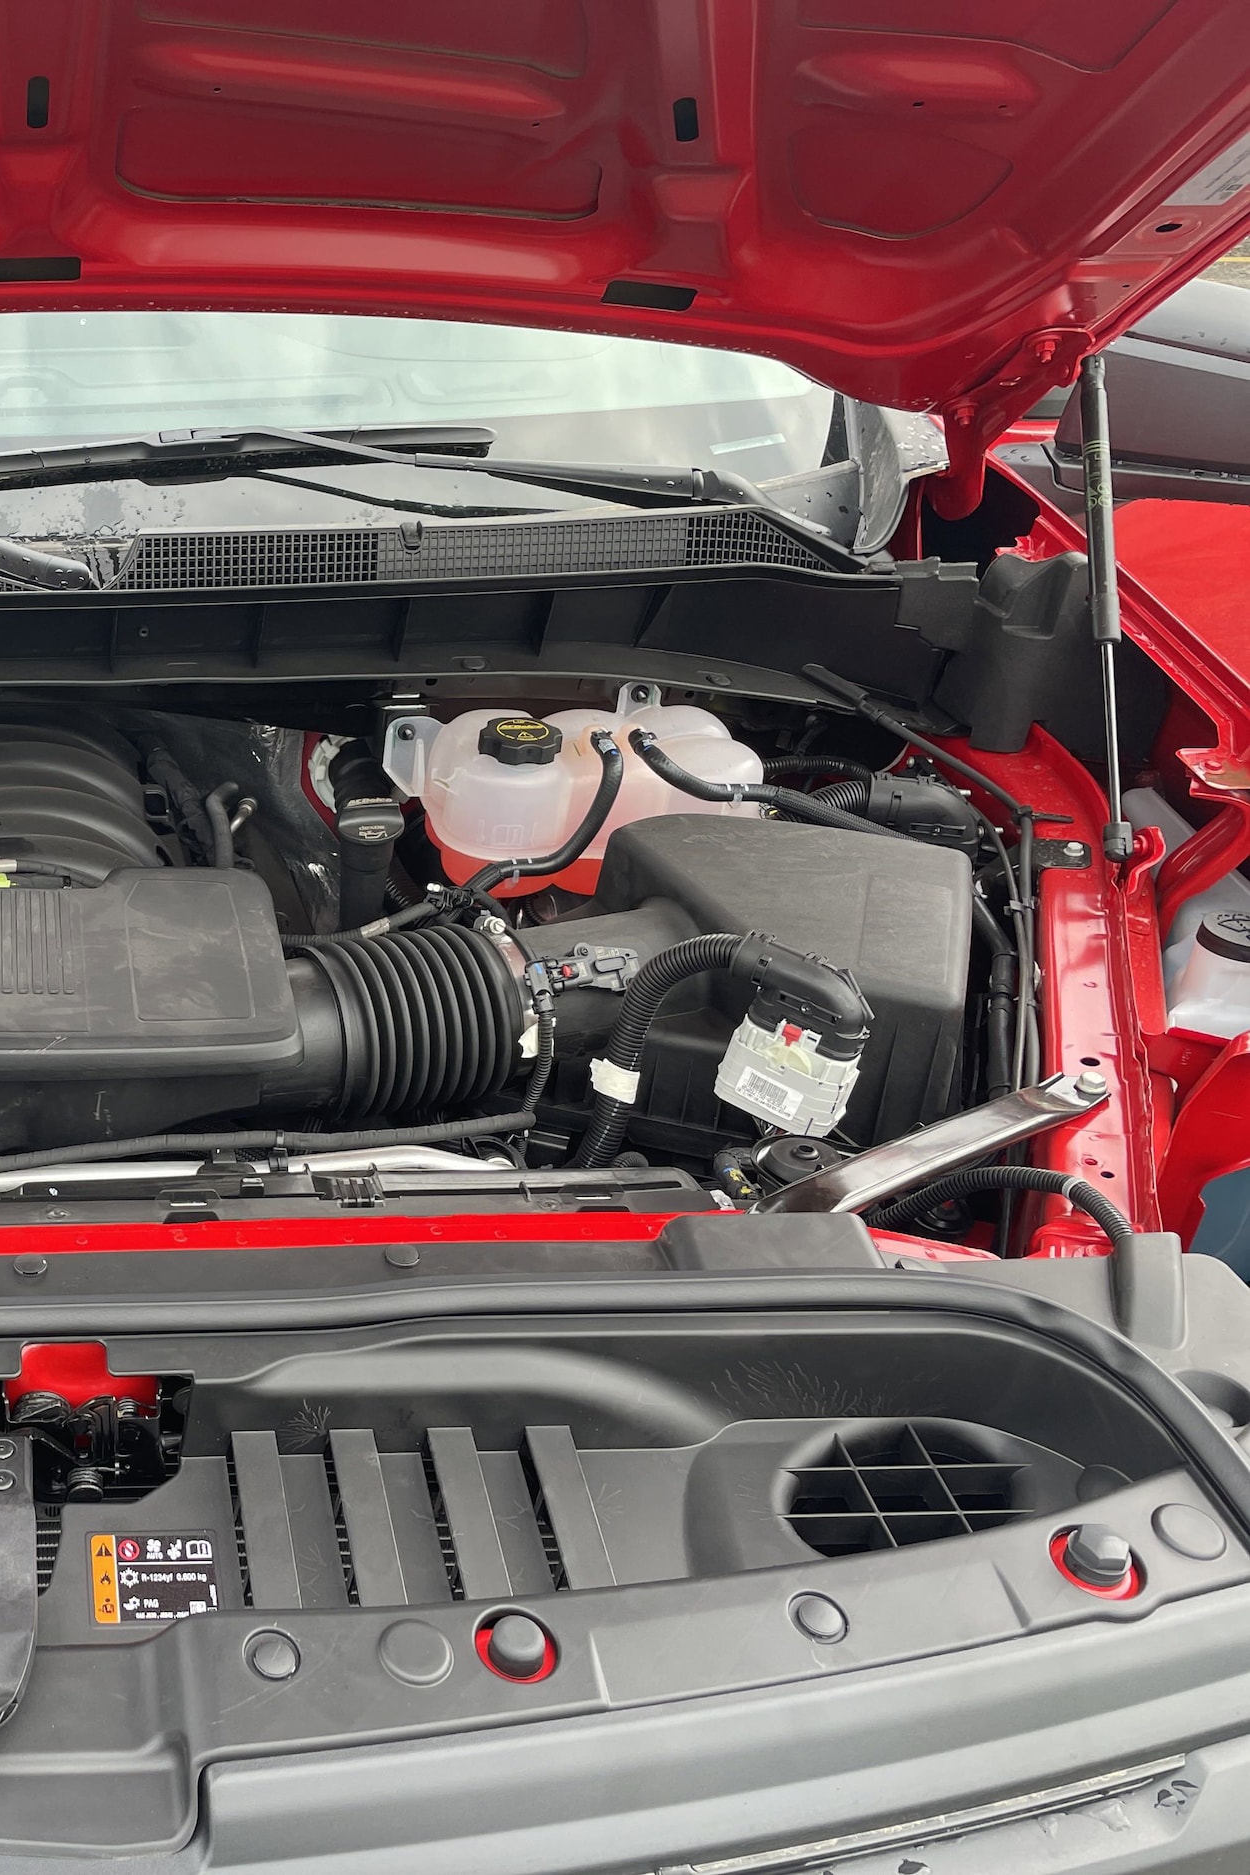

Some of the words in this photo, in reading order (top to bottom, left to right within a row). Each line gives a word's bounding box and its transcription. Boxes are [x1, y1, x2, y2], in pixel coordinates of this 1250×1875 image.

[146, 1552, 163, 1560] AUTO
[141, 1573, 173, 1583] R-1234yf
[197, 1572, 207, 1582] kg
[143, 1598, 159, 1608] PAG
